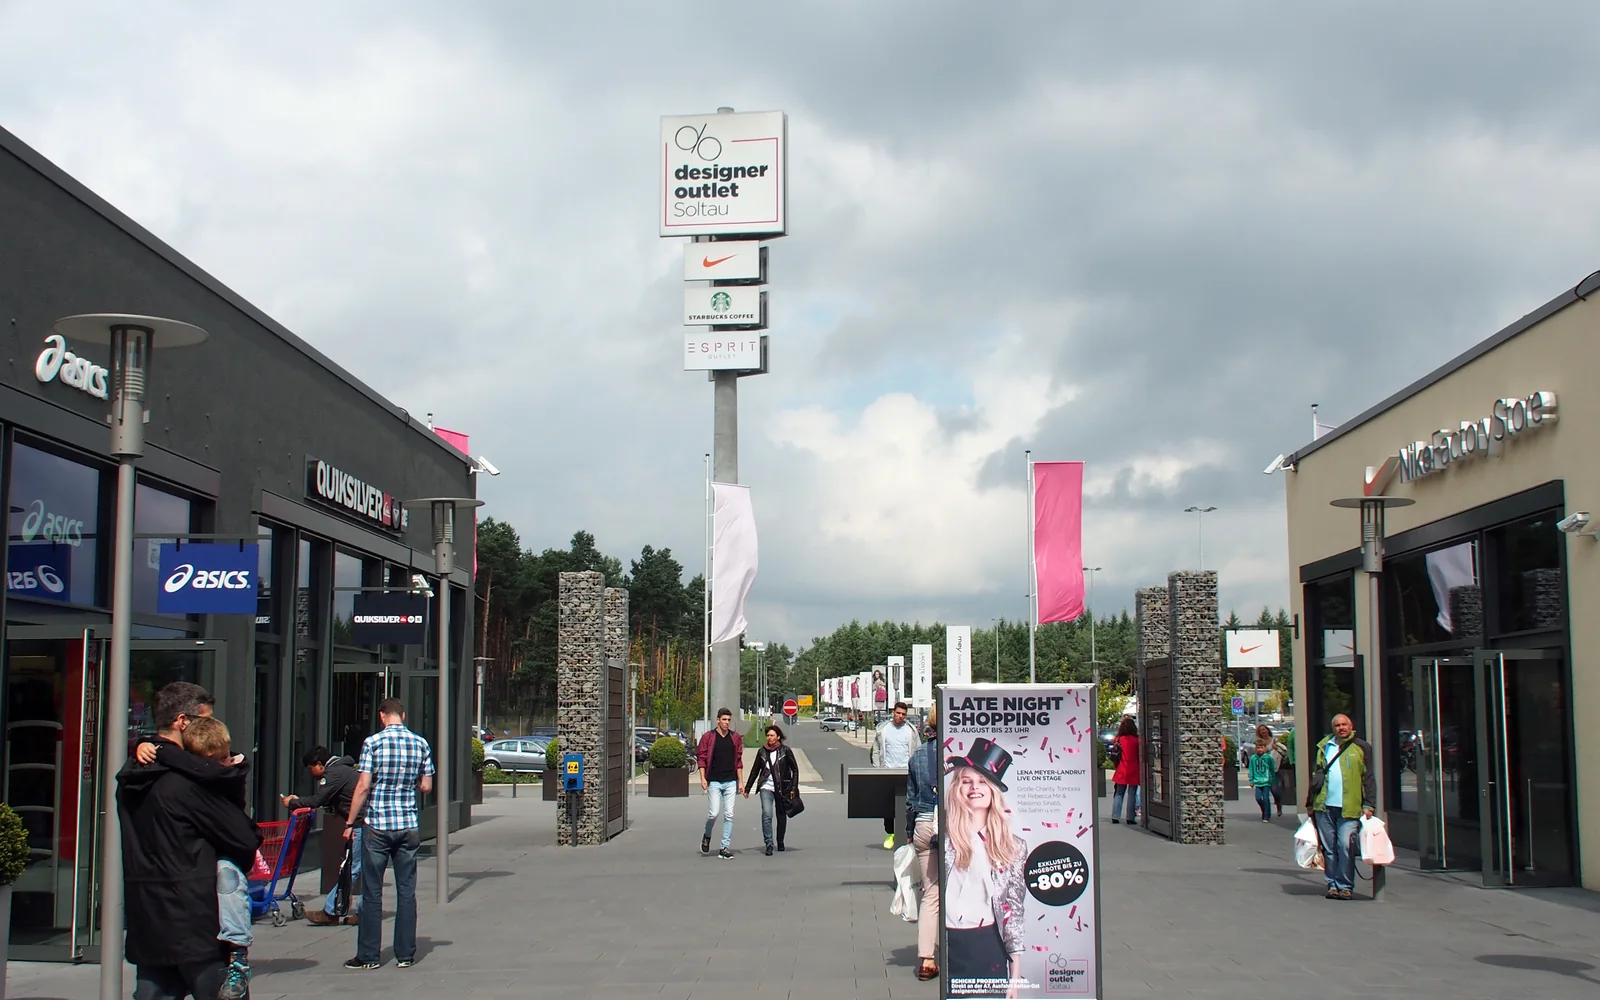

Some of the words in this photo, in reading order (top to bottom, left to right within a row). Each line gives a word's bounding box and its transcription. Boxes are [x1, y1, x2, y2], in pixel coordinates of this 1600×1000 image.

[674, 164, 768, 182] designer
[674, 182, 739, 199] outlet
[673, 201, 729, 217] Soltau
[688, 341, 756, 353] ESPRIT
[1399, 440, 1434, 483] Nike
[1431, 417, 1493, 466] Factory
[1493, 391, 1558, 442] Store
[316, 460, 383, 521] QUIKSILVER
[354, 615, 401, 624] QUIKSILVER
[949, 697, 998, 711] LATE
[1003, 697, 1063, 711] NIGHT
[948, 712, 1050, 726] SHOPPING
[1028, 865, 1062, 876] ANGEBOTE
[1073, 860, 1082, 868] ZU
[1037, 857, 1071, 868] EXKLUSIVE
[1049, 968, 1085, 976] designer
